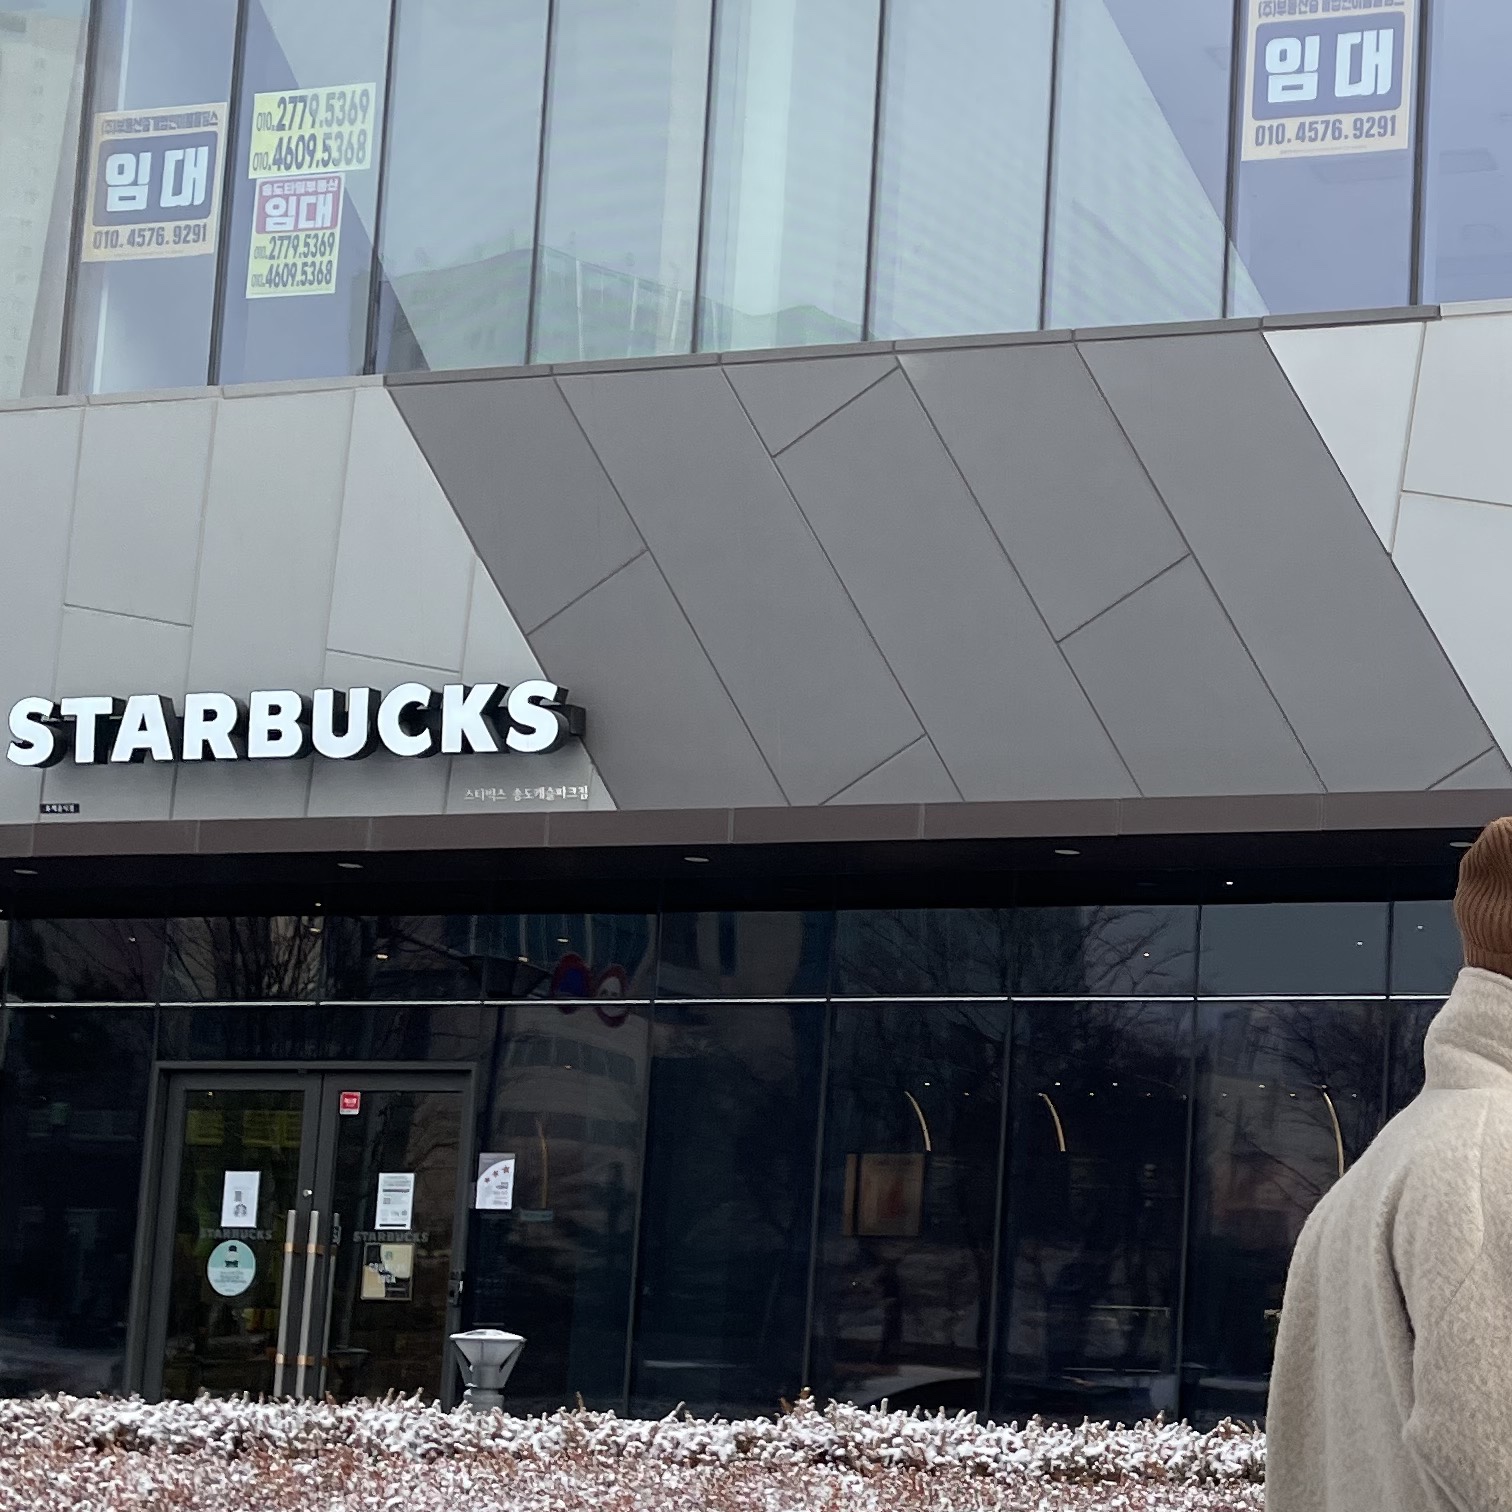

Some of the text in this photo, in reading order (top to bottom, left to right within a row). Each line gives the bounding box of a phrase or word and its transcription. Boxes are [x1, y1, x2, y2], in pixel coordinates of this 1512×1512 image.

[1265, 28, 1394, 103] 임대
[1254, 115, 1397, 147] 010.4576.9291
[105, 146, 209, 212] 임대
[93, 223, 208, 250] 010.4576.9291
[264, 193, 333, 232] 임대
[6, 679, 560, 768] STARBUCKS
